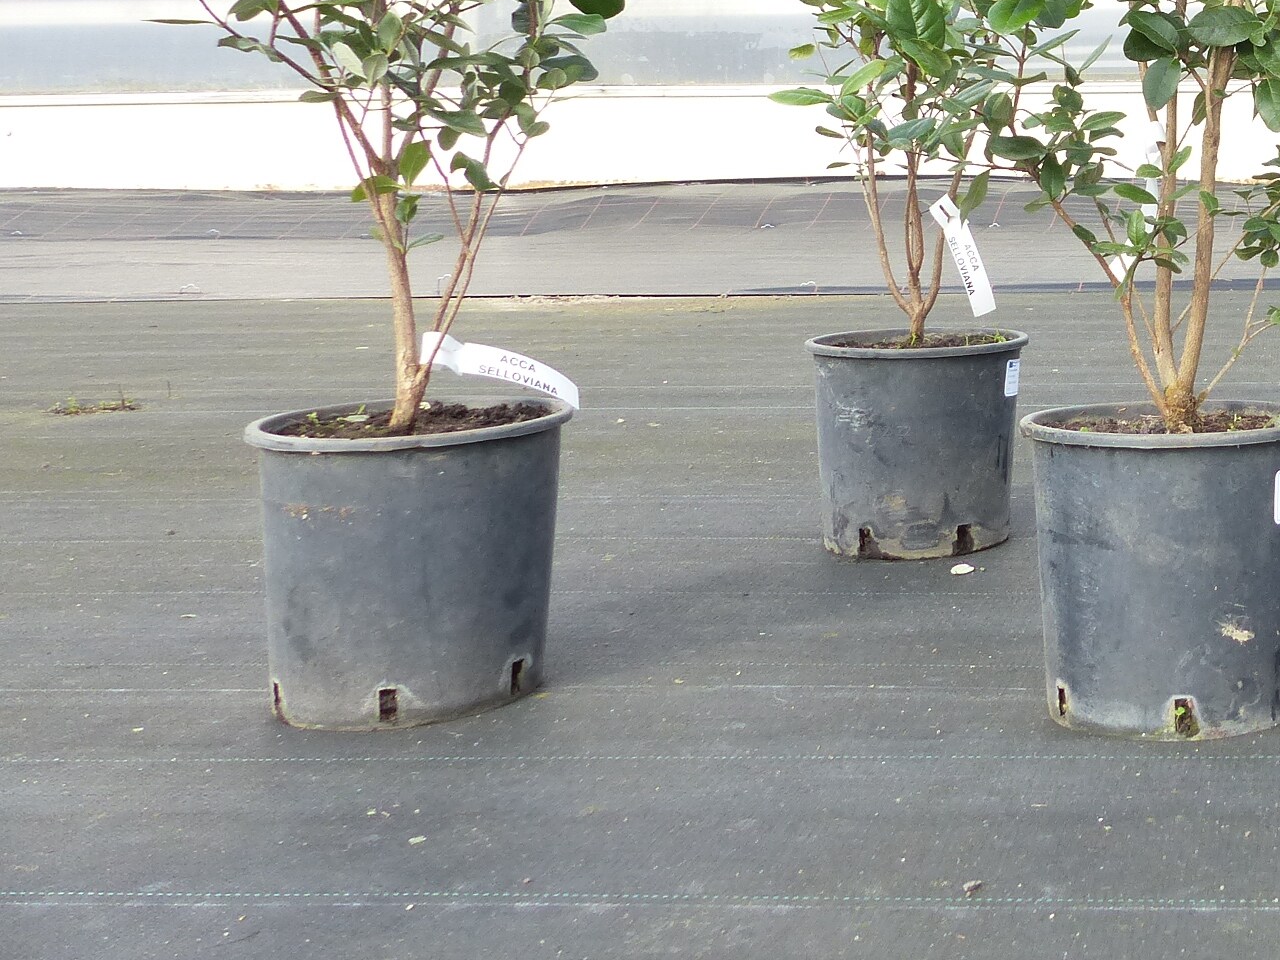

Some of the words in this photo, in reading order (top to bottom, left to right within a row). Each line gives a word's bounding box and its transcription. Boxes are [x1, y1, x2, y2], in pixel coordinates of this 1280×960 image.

[948, 236, 976, 296] SELLOVIANA
[964, 244, 980, 272] ACCA
[500, 355, 536, 373] ACCA
[478, 364, 559, 396] SELLOVIANA
